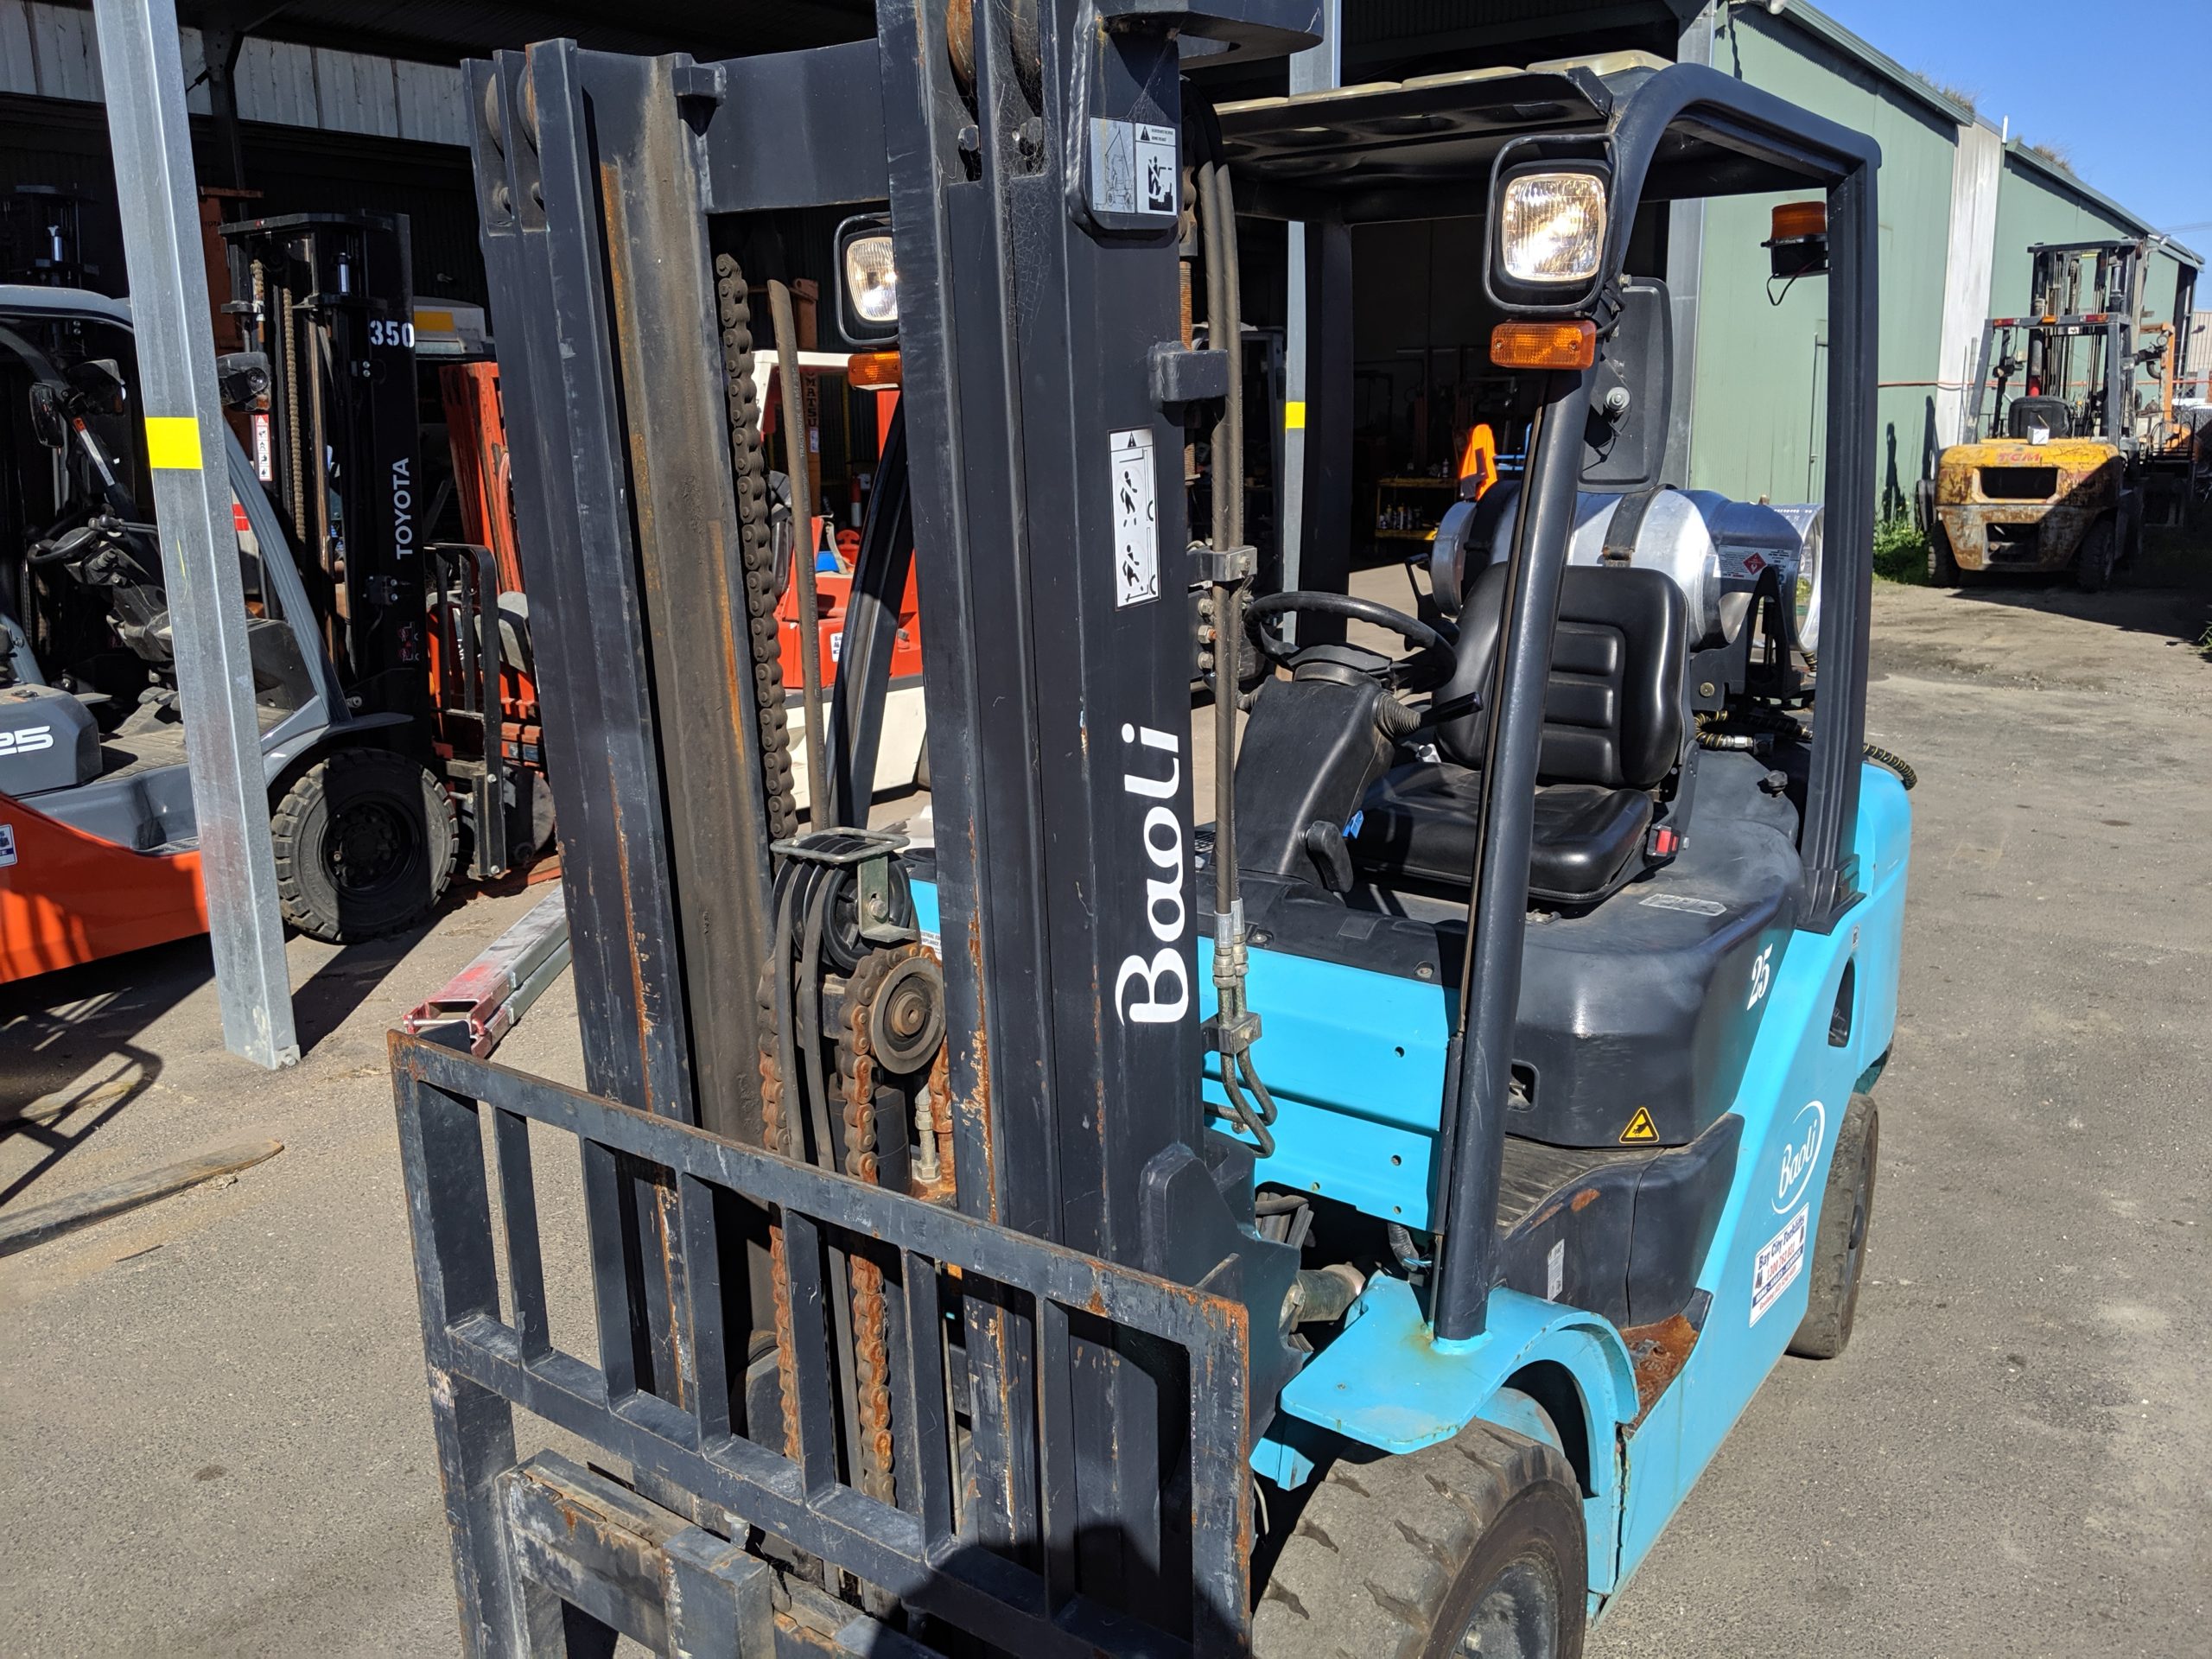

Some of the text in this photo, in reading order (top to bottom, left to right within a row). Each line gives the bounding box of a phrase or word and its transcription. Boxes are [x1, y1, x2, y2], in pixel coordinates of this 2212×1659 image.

[370, 320, 415, 348] 350
[1998, 453, 2040, 462] TCM
[392, 457, 413, 560] TOYOTA
[1115, 723, 1189, 1027] Baoli
[1746, 944, 1773, 1011] 25
[1778, 1119, 1818, 1199] Baoli
[1758, 1214, 1805, 1269] Bay City Forklifts
[1767, 1260, 1779, 1281] 1300
